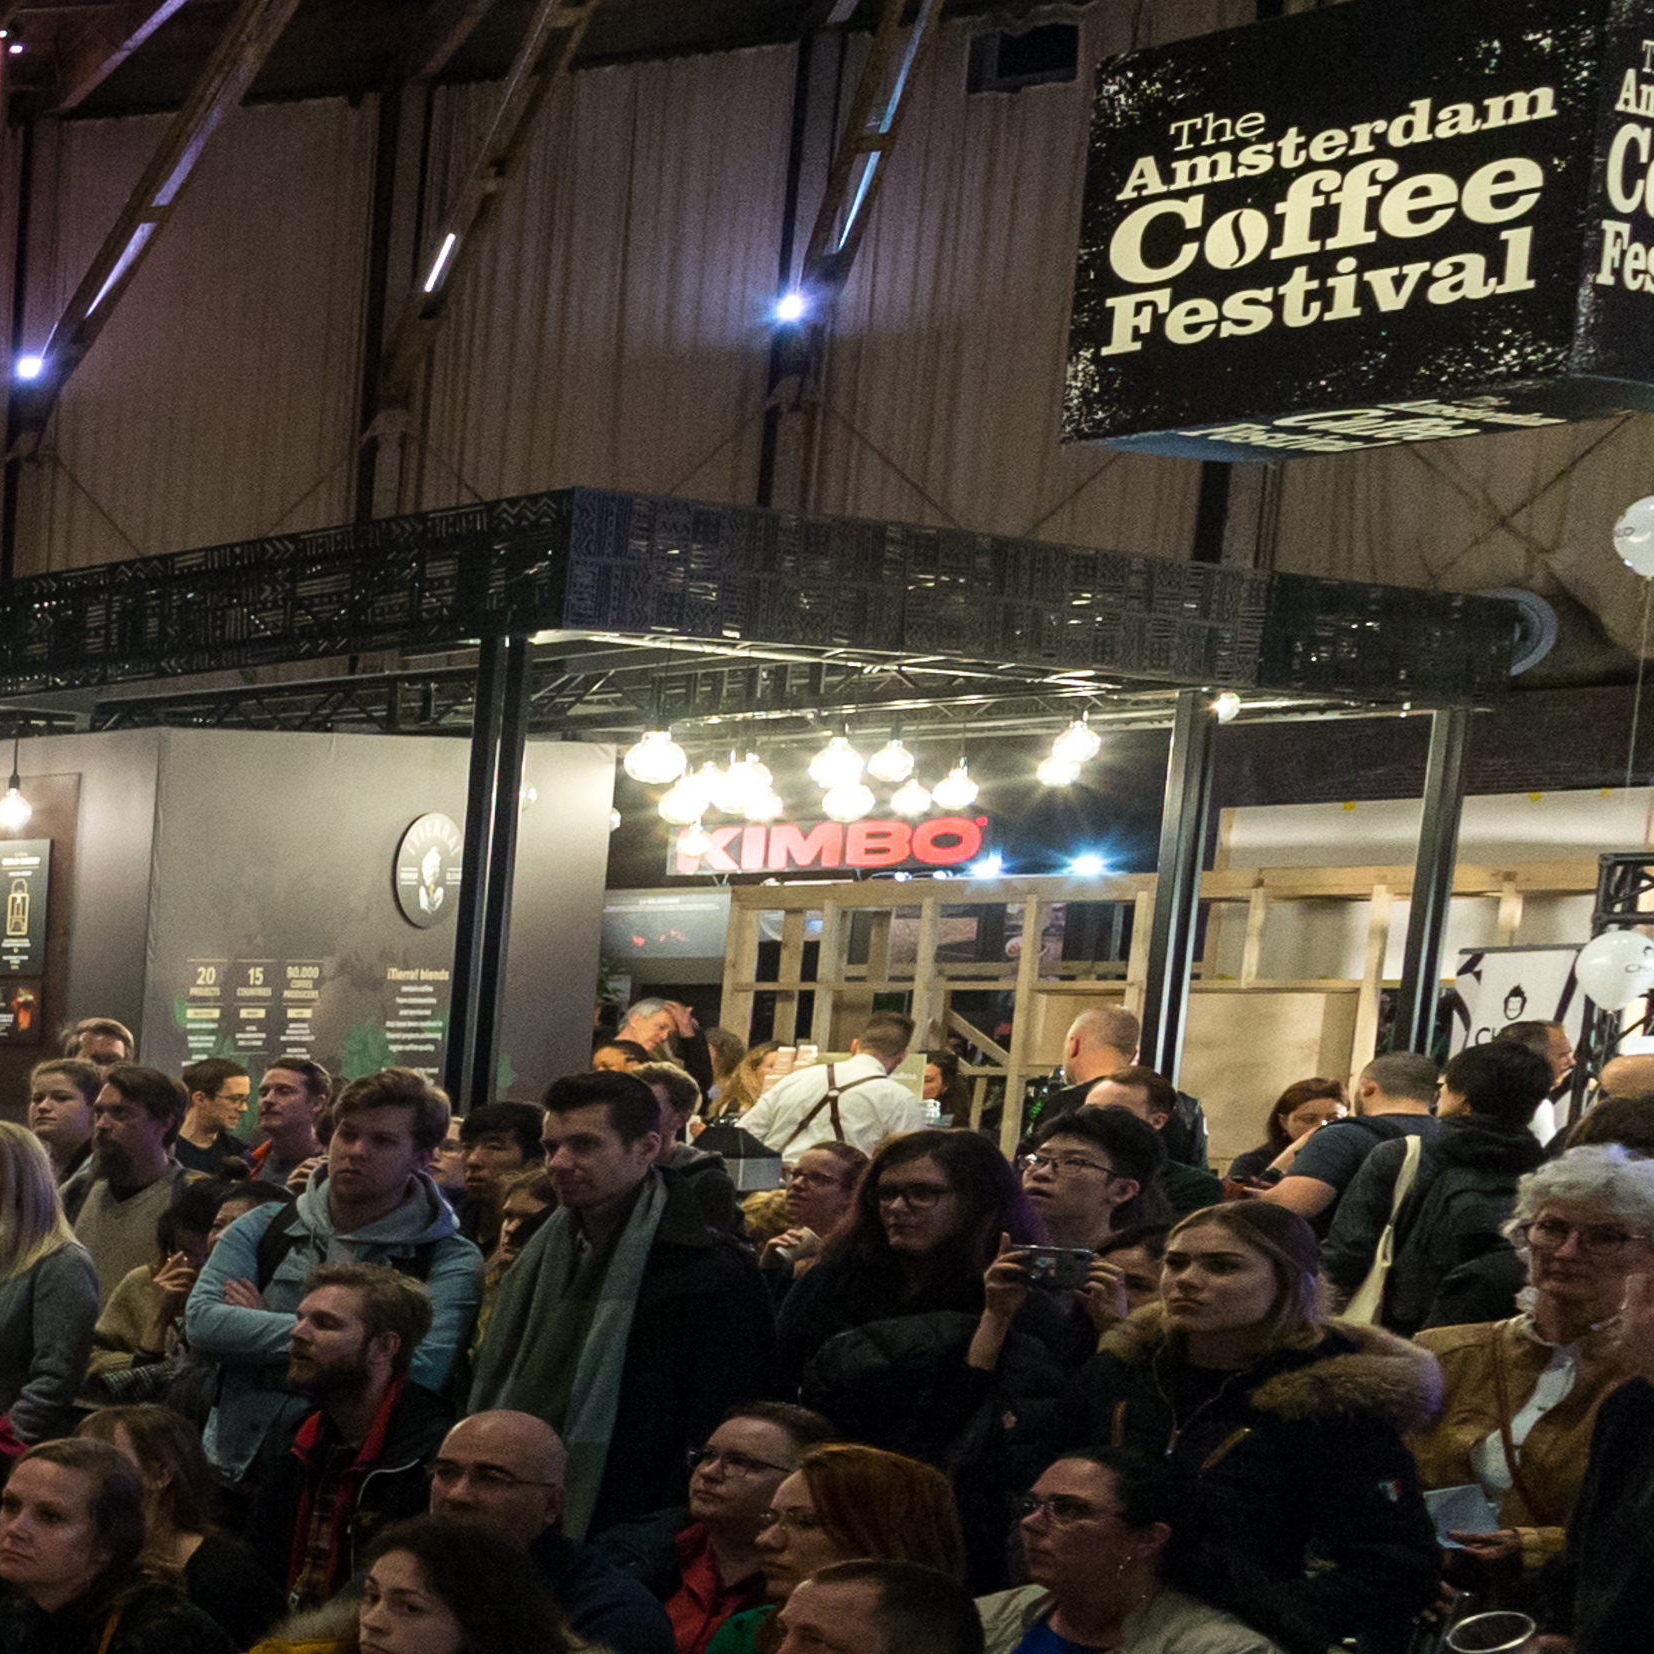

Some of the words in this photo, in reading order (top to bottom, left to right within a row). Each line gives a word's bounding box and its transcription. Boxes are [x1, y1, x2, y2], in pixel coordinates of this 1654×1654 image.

[1117, 86, 1557, 200] Amsterdam
[1170, 112, 1265, 151] The
[1109, 157, 1544, 284] Coffee
[1100, 226, 1535, 356] Festival
[675, 817, 982, 872] KIMBO
[196, 966, 216, 985] 20
[248, 966, 264, 985] 15
